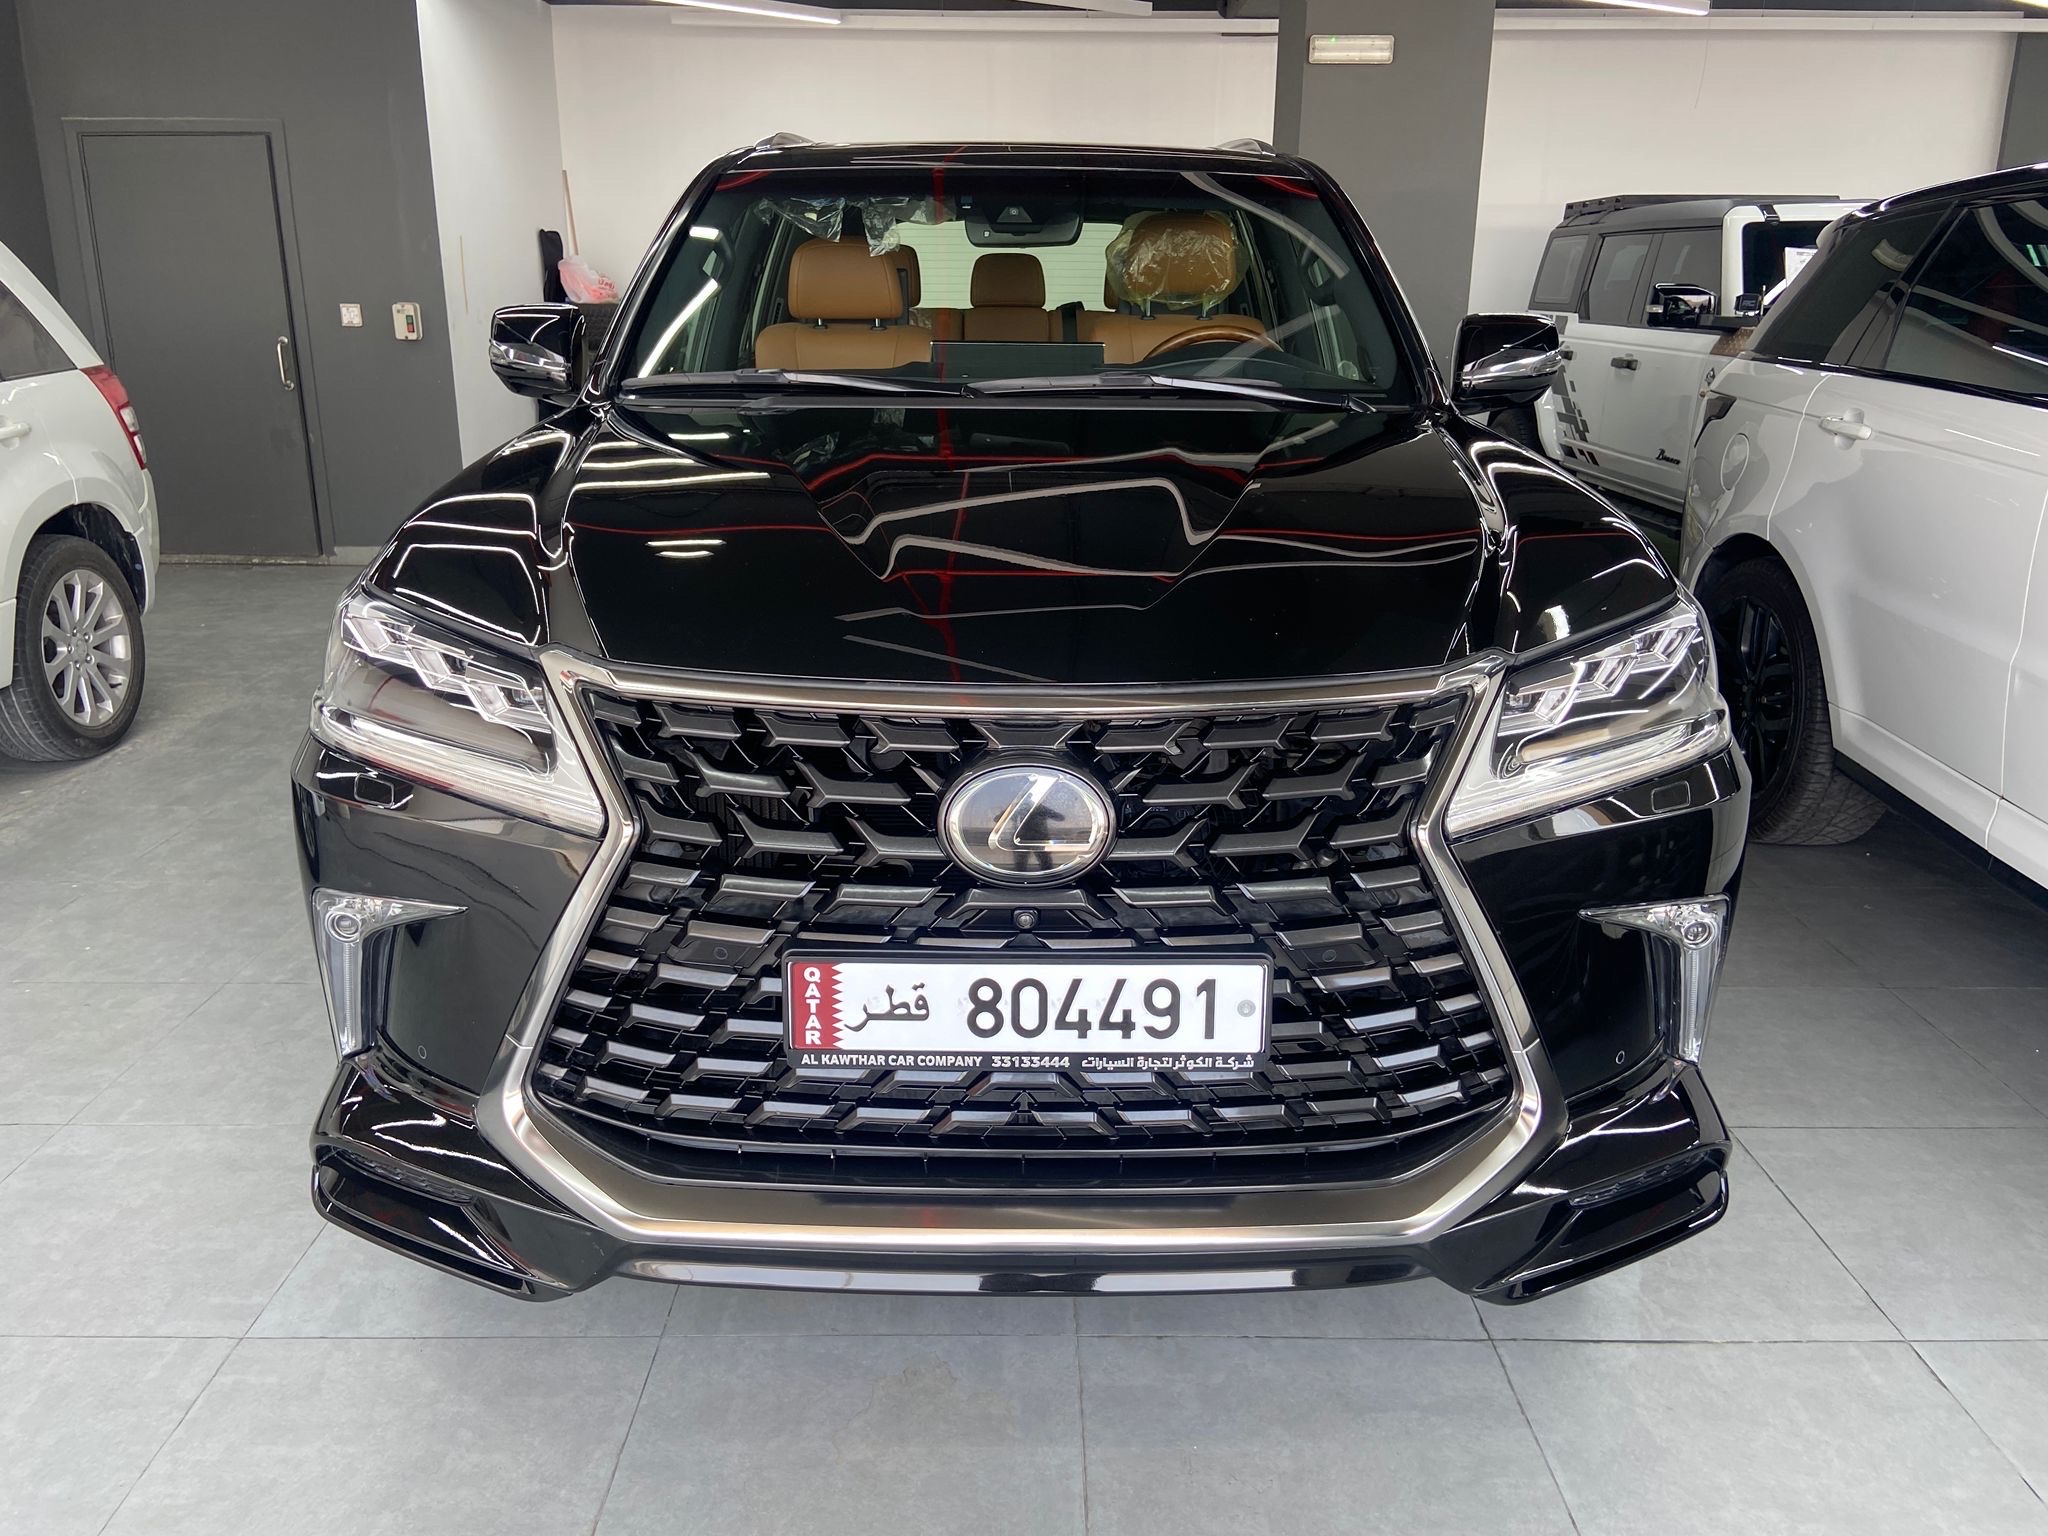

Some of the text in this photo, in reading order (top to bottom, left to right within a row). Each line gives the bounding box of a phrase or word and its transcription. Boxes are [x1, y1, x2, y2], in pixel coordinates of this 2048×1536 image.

[803, 966, 822, 1045] QATAR
[844, 982, 930, 1032] قطر
[967, 977, 1216, 1039] 804491
[801, 1053, 1070, 1068] AL KAWTHAR CAR COMPANY 33133444
[1081, 1056, 1134, 1070] السيارات
[1172, 1054, 1213, 1070] الكوثر
[1215, 1054, 1254, 1070] شركة
